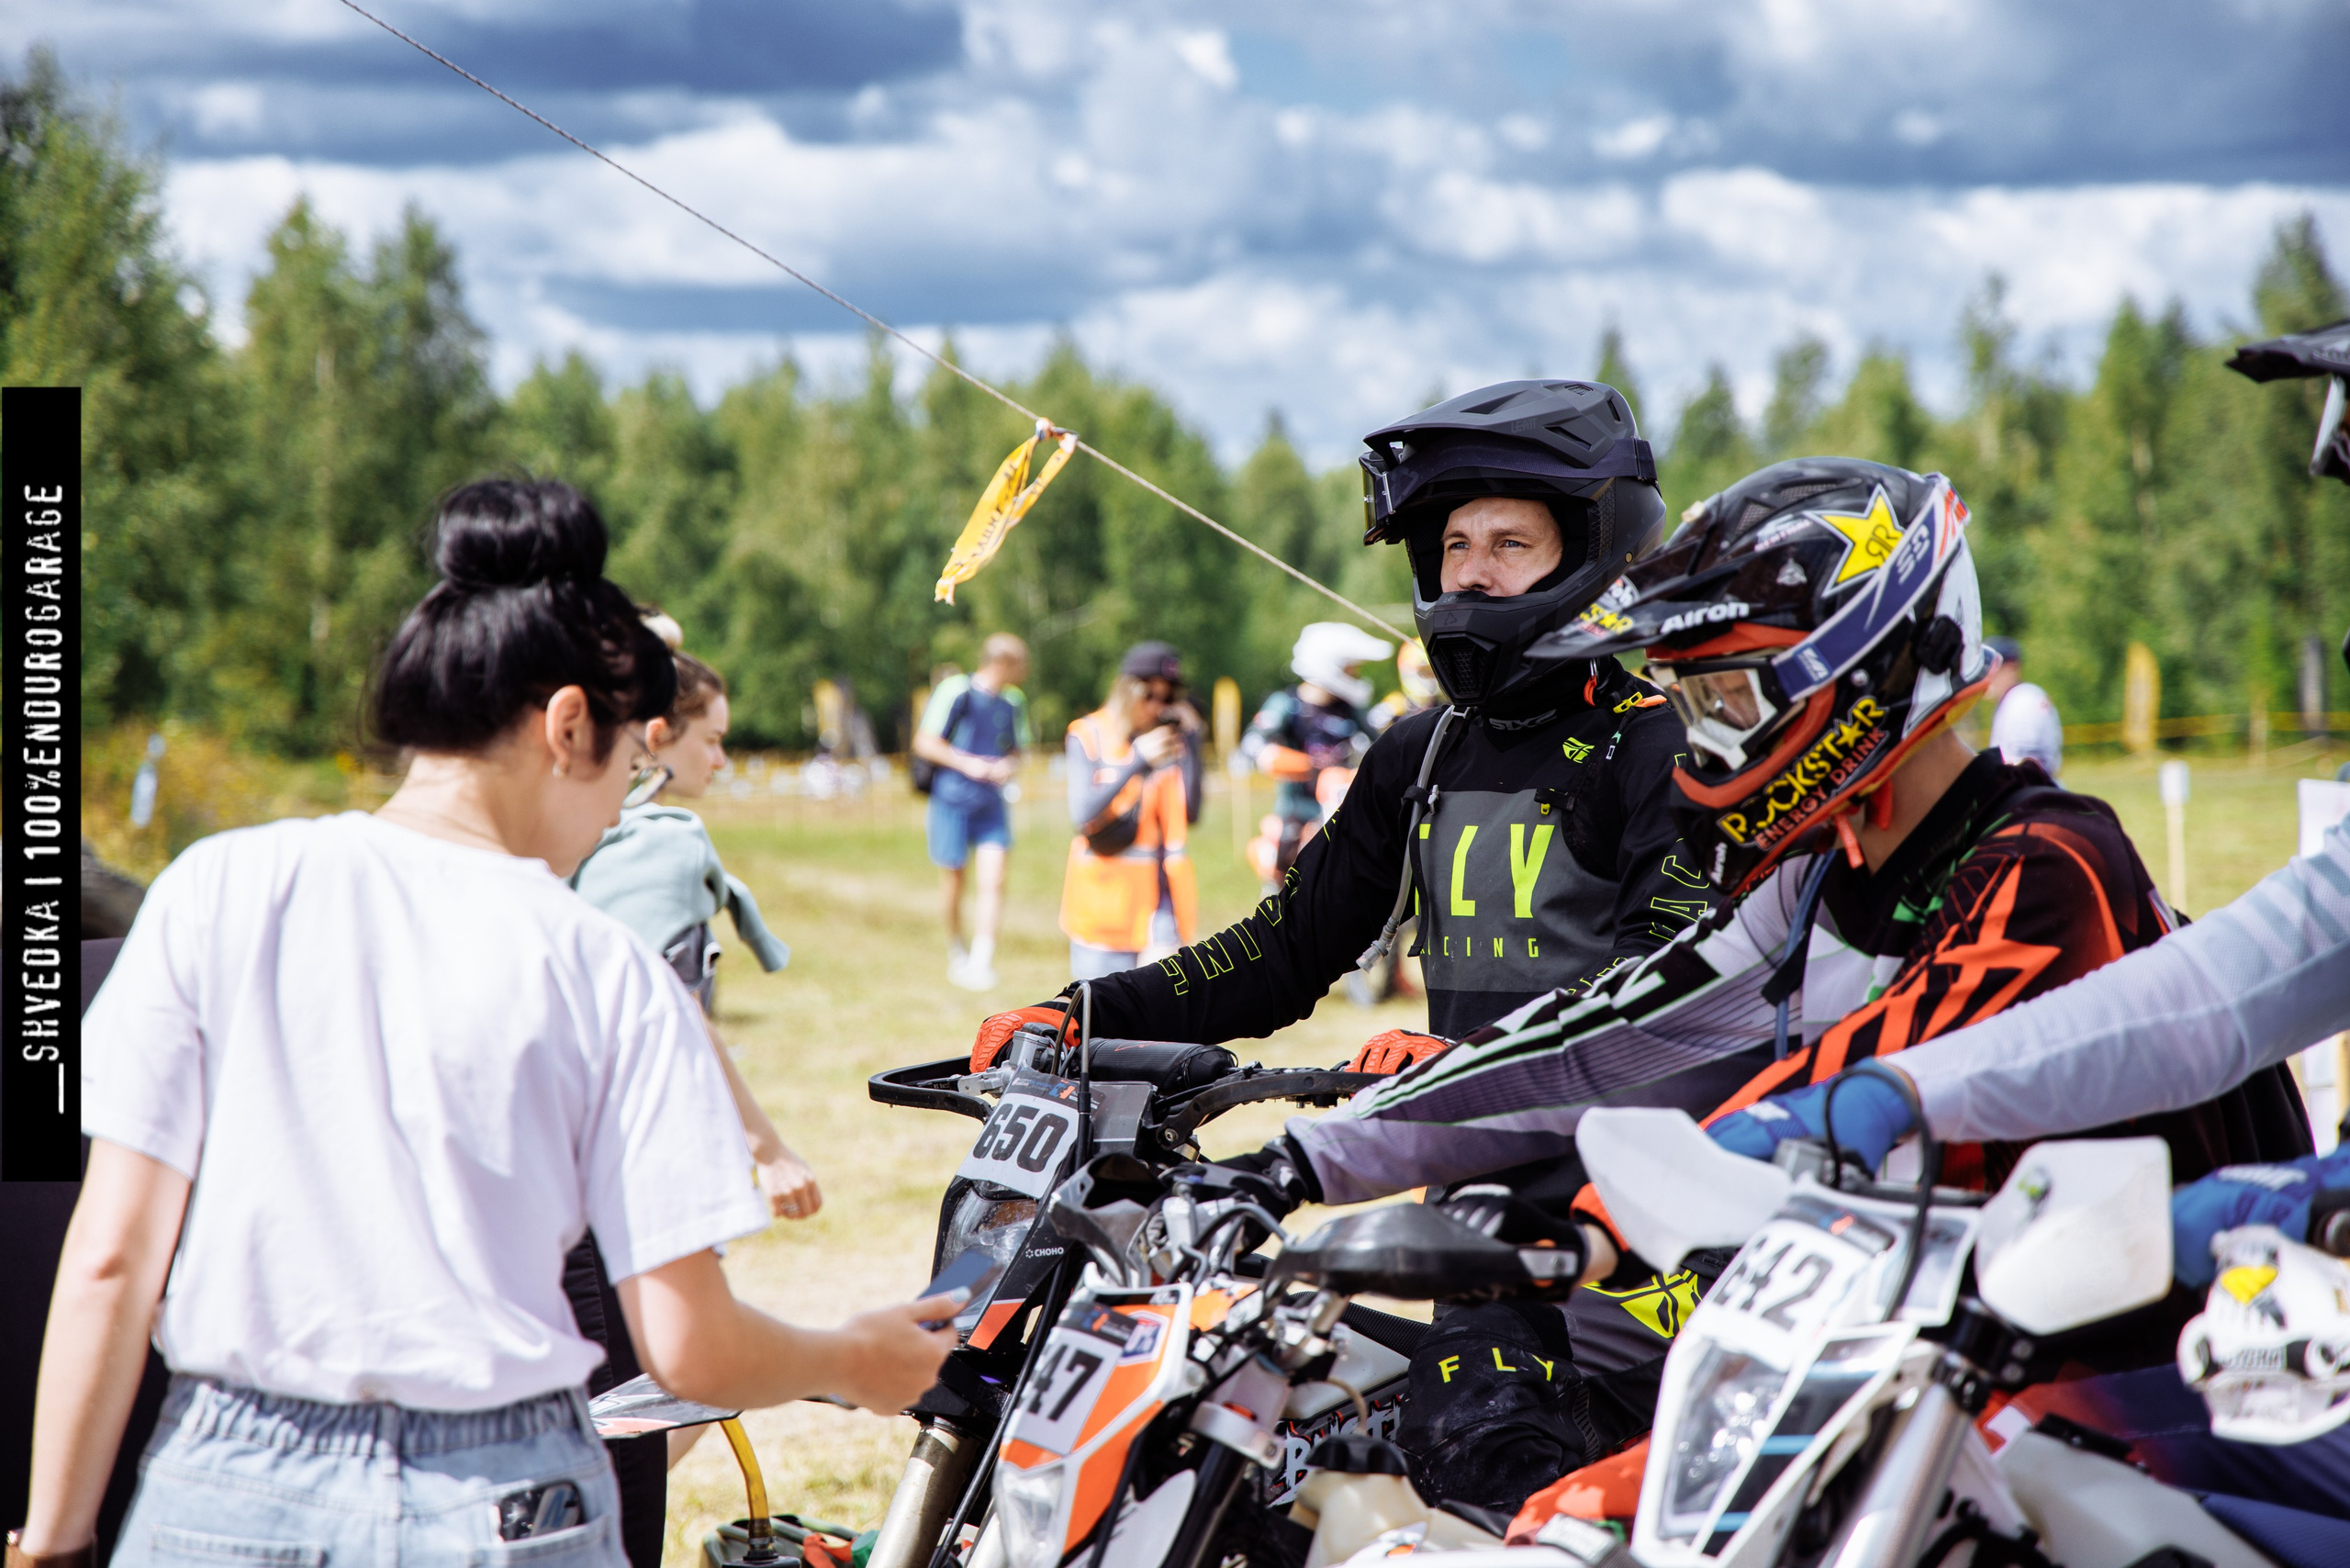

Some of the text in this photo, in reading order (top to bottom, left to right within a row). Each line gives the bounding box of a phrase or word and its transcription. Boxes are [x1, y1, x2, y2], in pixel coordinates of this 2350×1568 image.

[1754, 726, 1886, 848] ENERGY DRINK
[972, 1103, 1069, 1173] 650
[1035, 1247, 1065, 1257] CHOHO
[1438, 1347, 1554, 1383] FLY
